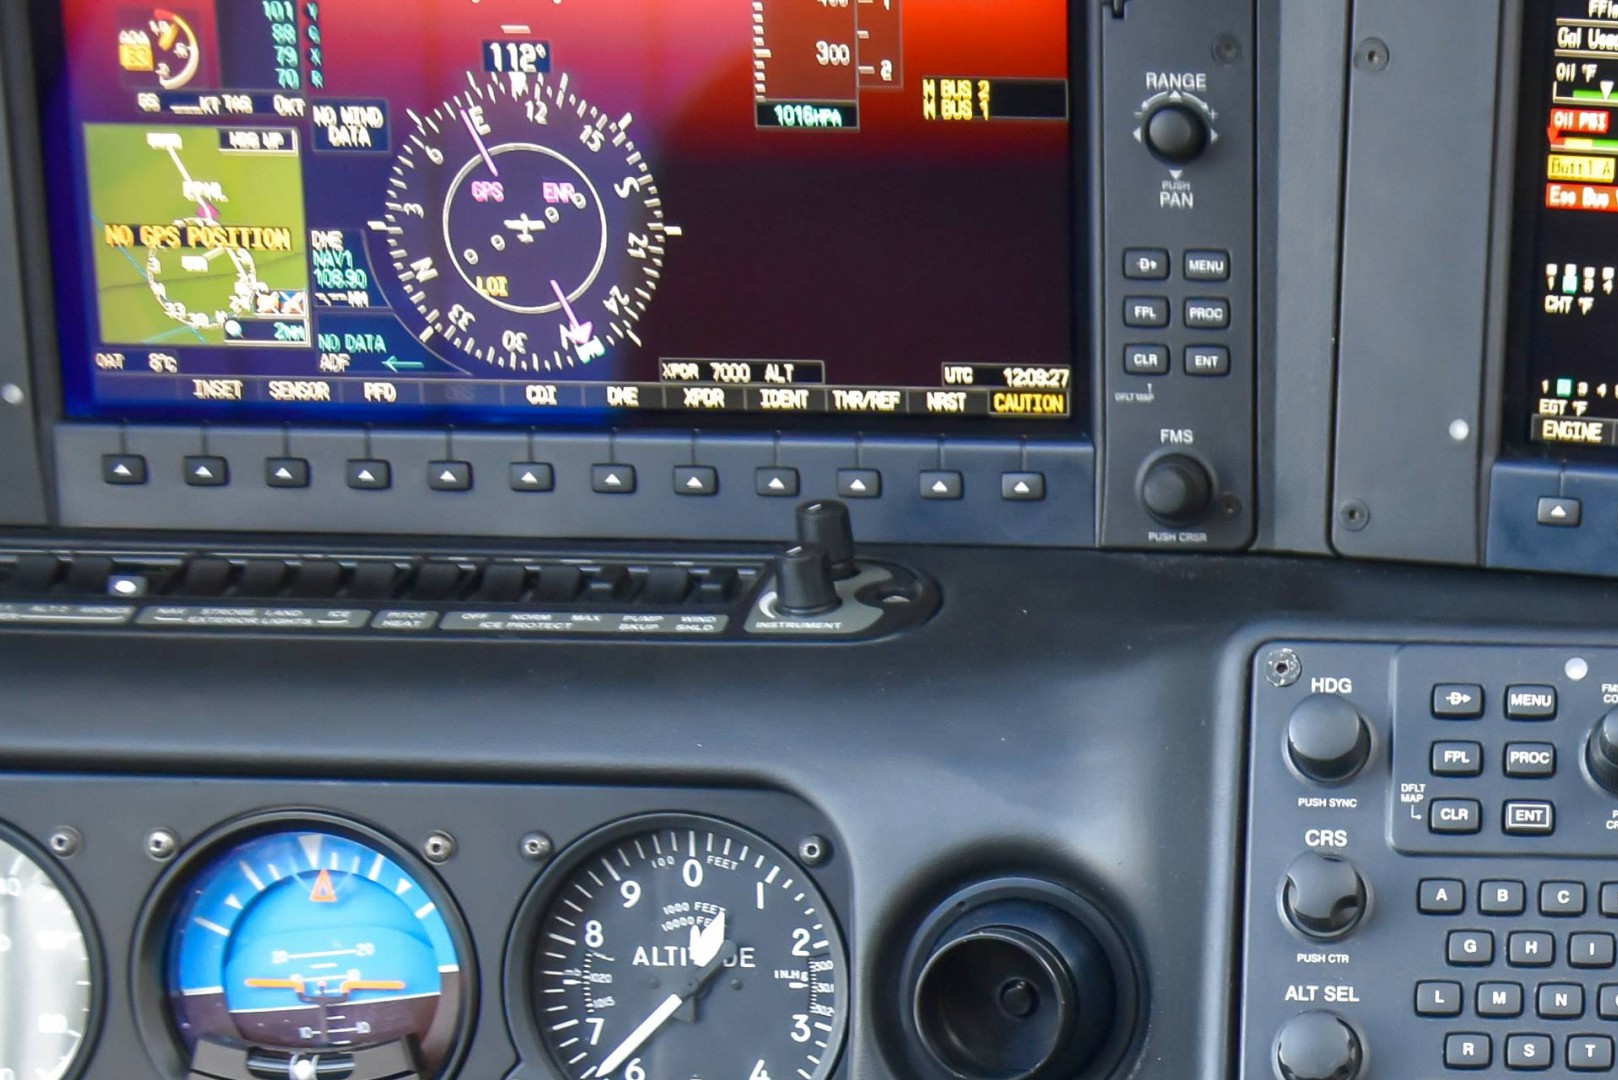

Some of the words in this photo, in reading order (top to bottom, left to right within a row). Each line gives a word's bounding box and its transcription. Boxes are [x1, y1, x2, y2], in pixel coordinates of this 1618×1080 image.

[264, 1, 294, 22] 101
[816, 41, 850, 66] 300
[1146, 73, 1207, 89] RANGE
[1160, 192, 1194, 209] PAN
[104, 224, 134, 247] NO
[139, 225, 181, 249] GPS
[187, 225, 291, 251] POSITION
[1189, 260, 1224, 271] MENU
[1135, 306, 1156, 318] FPL
[1189, 308, 1223, 320] PROC
[344, 334, 387, 352] DATA
[1134, 354, 1158, 366] CLR
[1195, 355, 1219, 367] ENT
[710, 363, 751, 383] 7000
[765, 364, 795, 383] ALT
[192, 379, 244, 400] INSET
[268, 381, 331, 401] SENSOR
[363, 382, 397, 402] PFD
[526, 385, 557, 406] CDI
[607, 386, 639, 407] DME
[760, 389, 809, 410] IDENT
[927, 392, 967, 412] NRST
[994, 393, 1064, 414] CAUTION
[1160, 429, 1193, 444] FMS
[1542, 420, 1602, 442] ENGINE
[1311, 677, 1352, 694] HDG
[1511, 694, 1552, 706] MENU
[1444, 751, 1470, 763] FPL
[1510, 752, 1550, 764] PROC
[1298, 798, 1326, 808] PUSH
[1329, 798, 1357, 808] SYNC
[1440, 809, 1468, 821] CLR
[1515, 810, 1543, 822] ENT
[1305, 829, 1348, 847] CRS
[707, 857, 738, 871] FEET
[682, 859, 703, 888] 0
[620, 880, 641, 908] 9
[584, 921, 603, 948] 8
[791, 928, 810, 957] 2
[1297, 954, 1326, 963] PUSH
[1328, 954, 1350, 964] CTR
[1285, 985, 1319, 1002] ALT
[1324, 986, 1360, 1002] SEL
[585, 1018, 604, 1045] 7
[790, 1014, 811, 1042] 3
